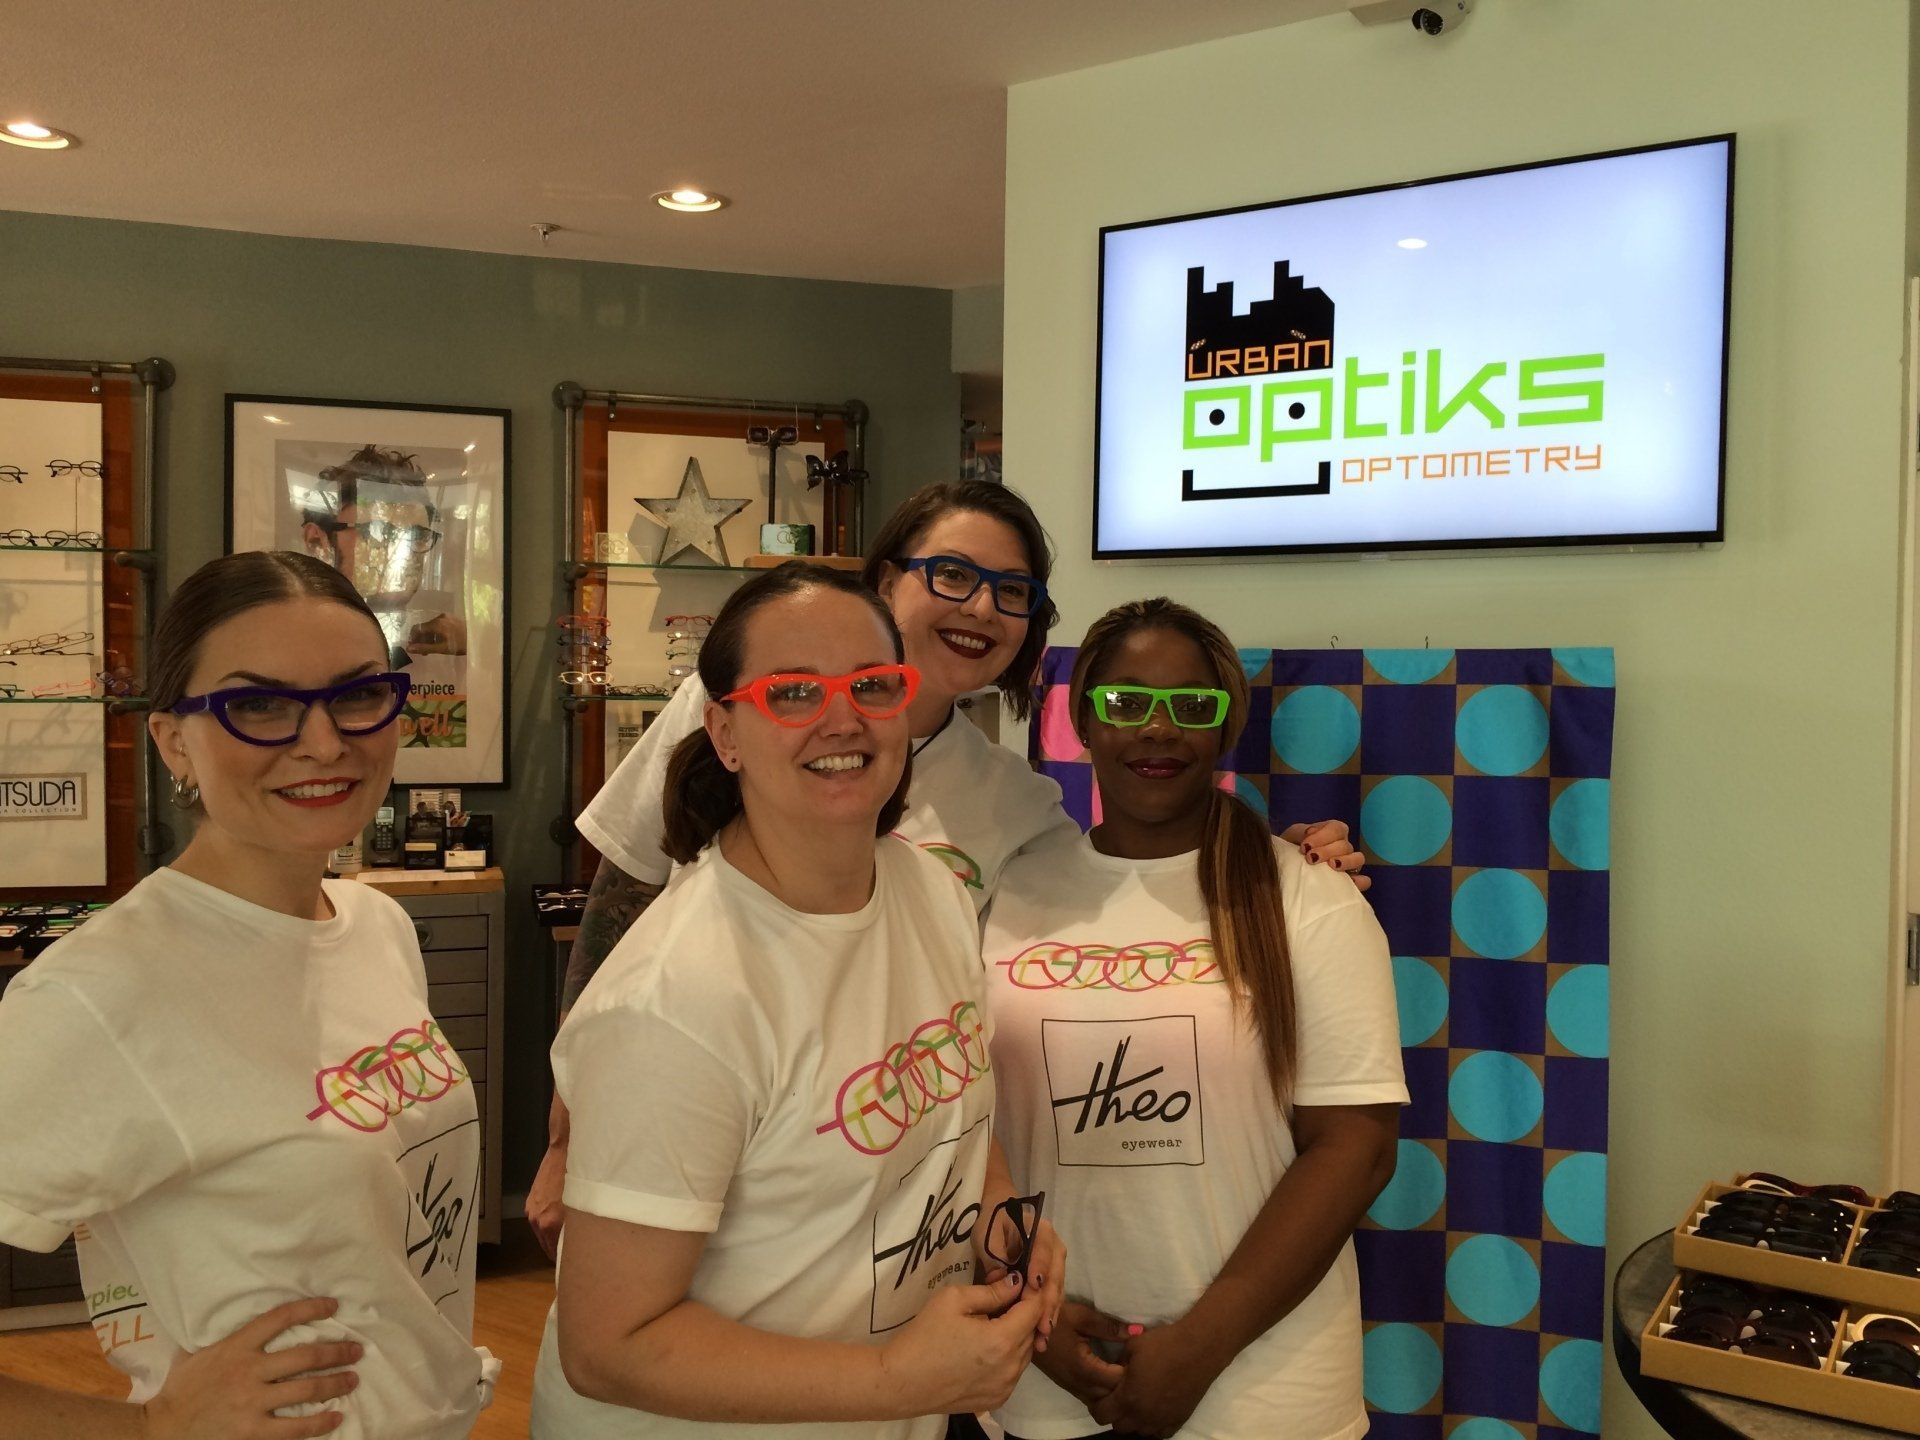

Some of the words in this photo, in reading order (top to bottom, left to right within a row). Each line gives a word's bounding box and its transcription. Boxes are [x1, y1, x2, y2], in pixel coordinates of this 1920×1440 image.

[1188, 339, 1330, 379] URBAN
[1183, 348, 1604, 463] optiks
[1342, 444, 1602, 483] OPTOMETRY
[410, 680, 455, 699] erpiece
[0, 780, 76, 806] TSUDA
[1053, 1035, 1192, 1134] theo
[1121, 1138, 1183, 1152] eyewear
[927, 1260, 970, 1290] eyewear
[86, 1283, 139, 1311] piec
